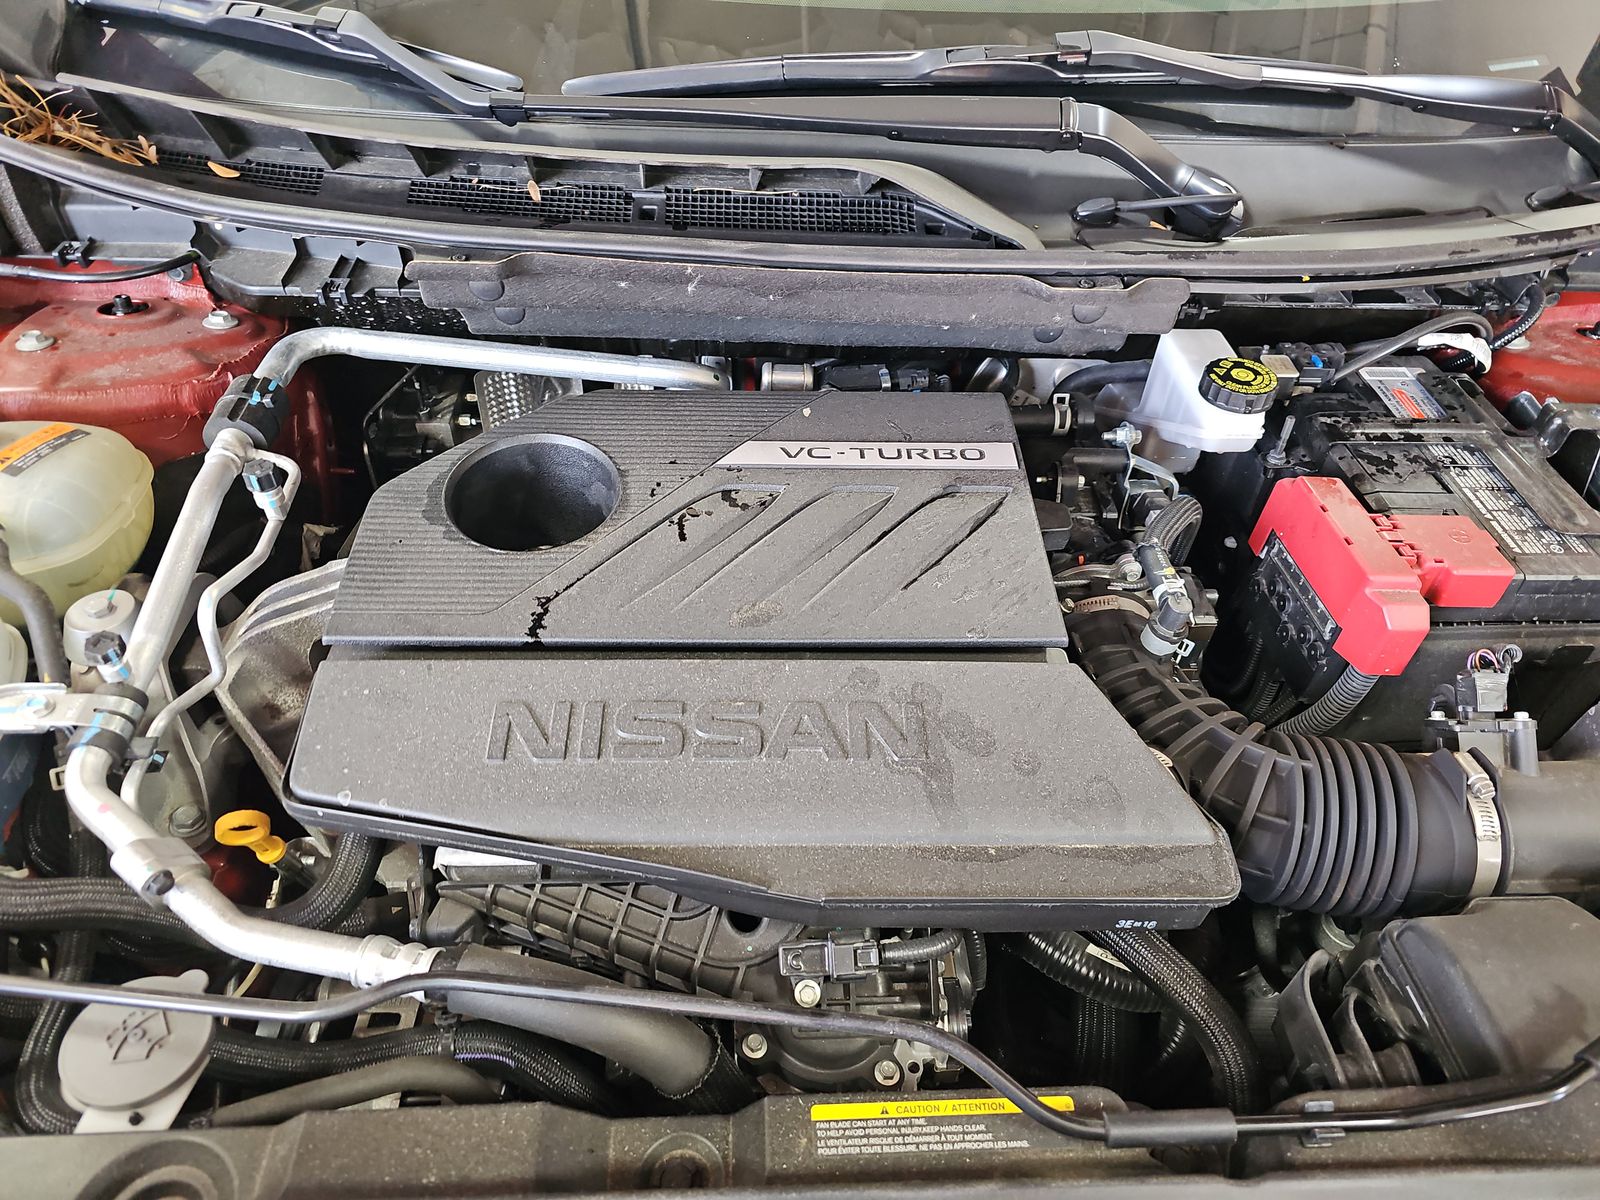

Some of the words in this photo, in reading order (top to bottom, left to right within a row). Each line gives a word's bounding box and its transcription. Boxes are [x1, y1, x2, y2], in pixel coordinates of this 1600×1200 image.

[779, 446, 986, 461] VC-TURBO
[485, 700, 929, 762] NISSAN
[896, 1104, 940, 1114] CAUTION
[951, 1101, 1006, 1112] ATTENTION
[816, 1121, 829, 1129] FAN
[852, 1119, 866, 1128] CAN
[867, 1118, 887, 1127] START
[888, 1118, 896, 1126] AT
[896, 1118, 911, 1126] ANY
[817, 1129, 826, 1137] TO
[827, 1128, 844, 1137] HELP
[845, 1127, 864, 1136] AVOID
[865, 1126, 900, 1136] PERSONAL
[940, 1124, 963, 1132] HANDS
[817, 1139, 826, 1147] LE
[827, 1137, 868, 1146] VENTILATEUR
[869, 1136, 893, 1145] RISQUE
[894, 1136, 904, 1144] DE
[818, 1147, 837, 1155] POUR
[861, 1145, 882, 1154] TOUTE
[919, 1143, 928, 1152] NE
[929, 1142, 943, 1151] PAS
[943, 1142, 953, 1150] EN
[954, 1141, 994, 1150] APPROCHER
[994, 1140, 1007, 1149] LES
